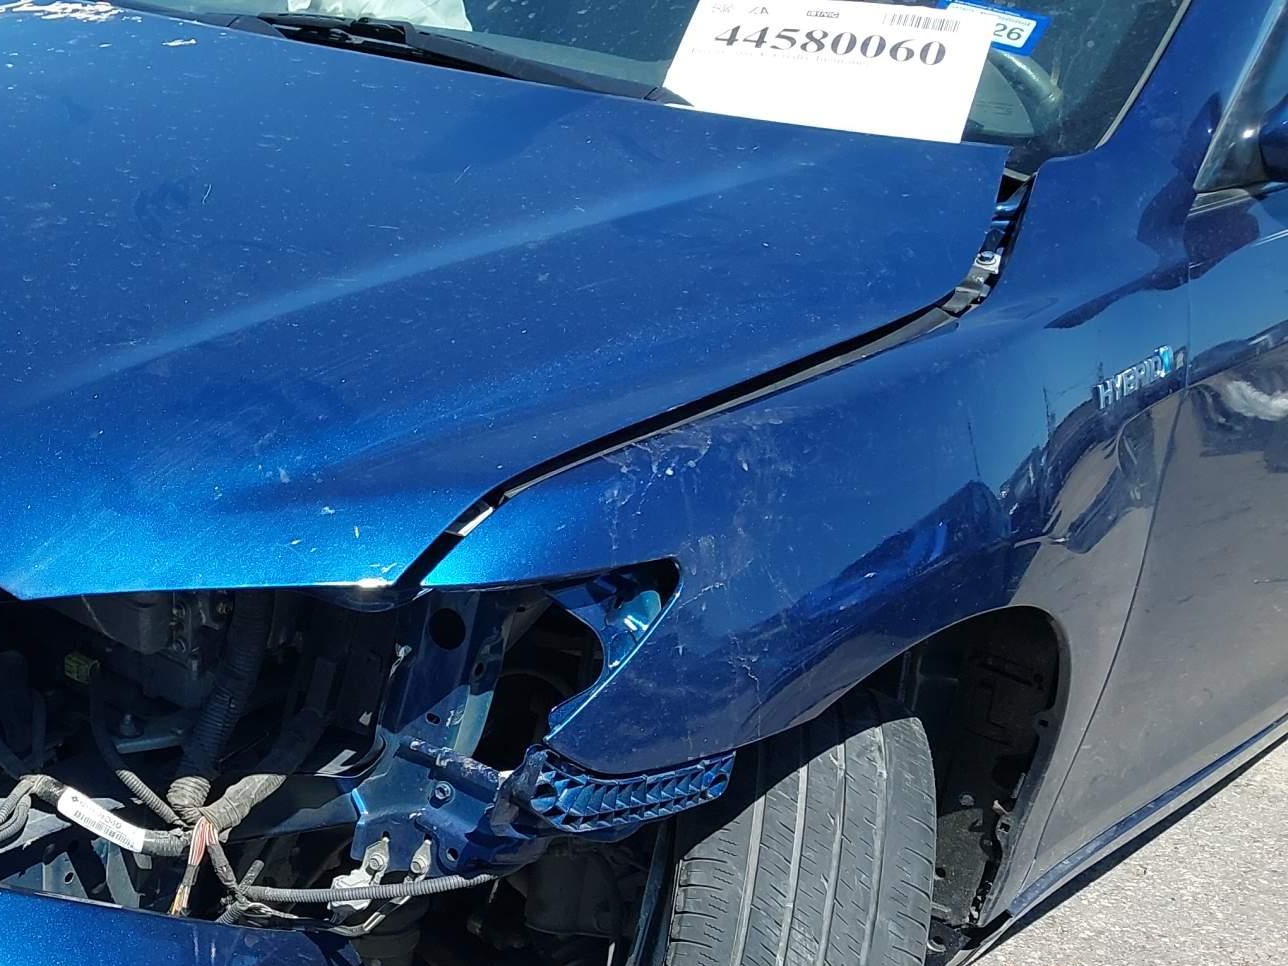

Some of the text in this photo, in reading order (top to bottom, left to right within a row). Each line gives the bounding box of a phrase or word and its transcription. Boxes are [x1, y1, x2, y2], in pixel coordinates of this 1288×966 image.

[714, 24, 946, 66] 44580060
[992, 22, 1025, 41] 26
[1097, 354, 1162, 410] HYBRID
